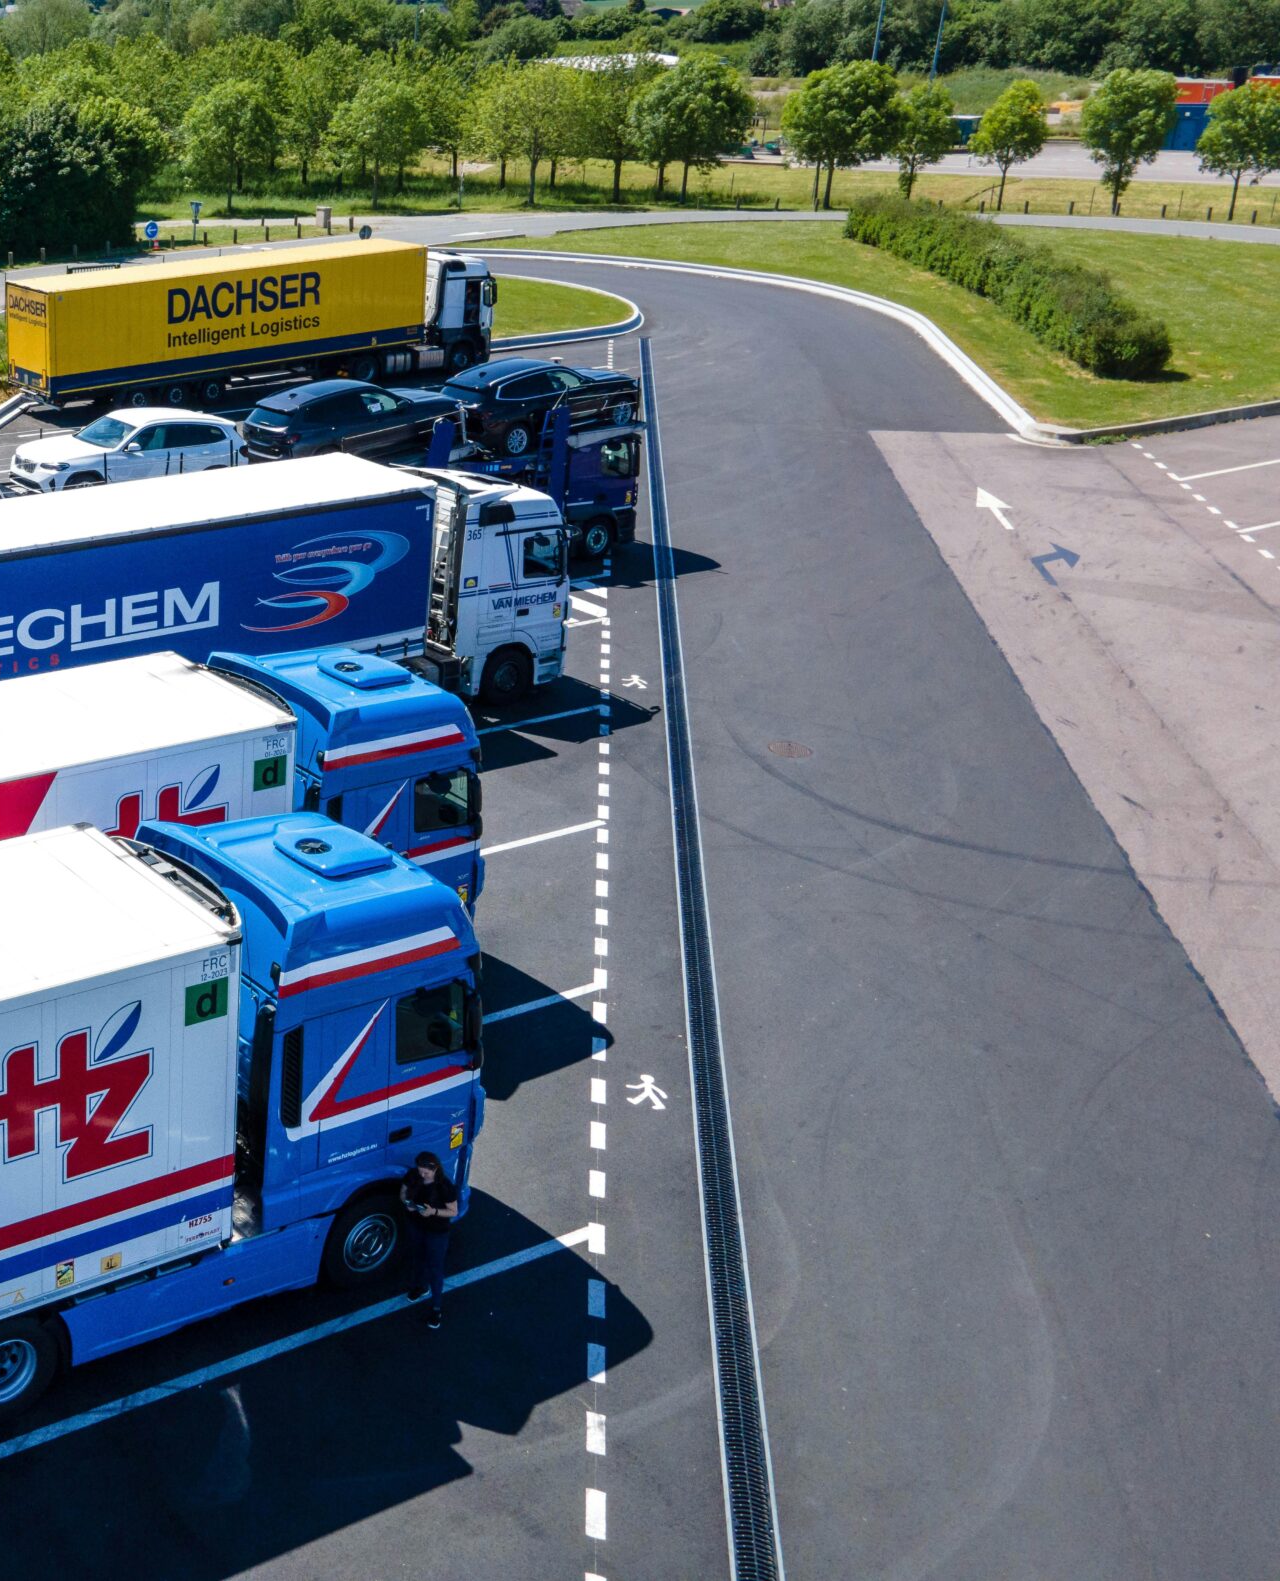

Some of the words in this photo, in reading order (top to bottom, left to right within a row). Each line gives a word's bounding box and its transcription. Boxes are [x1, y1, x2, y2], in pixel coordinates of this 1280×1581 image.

[9, 294, 47, 319] DACHSER
[167, 271, 321, 325] DACHSER
[167, 323, 247, 348] Intelligent
[250, 315, 320, 339] Logistics
[467, 529, 482, 541] 365
[492, 596, 513, 610] VAN
[513, 590, 557, 608] MIEGHEM
[266, 737, 285, 750] FRC
[262, 758, 279, 786] d
[202, 954, 227, 973] FRC
[200, 968, 228, 982] 12-2023
[195, 980, 218, 1018] d
[328, 1143, 378, 1163] www.hzlogistics.eu
[189, 1214, 213, 1228] HZ755
